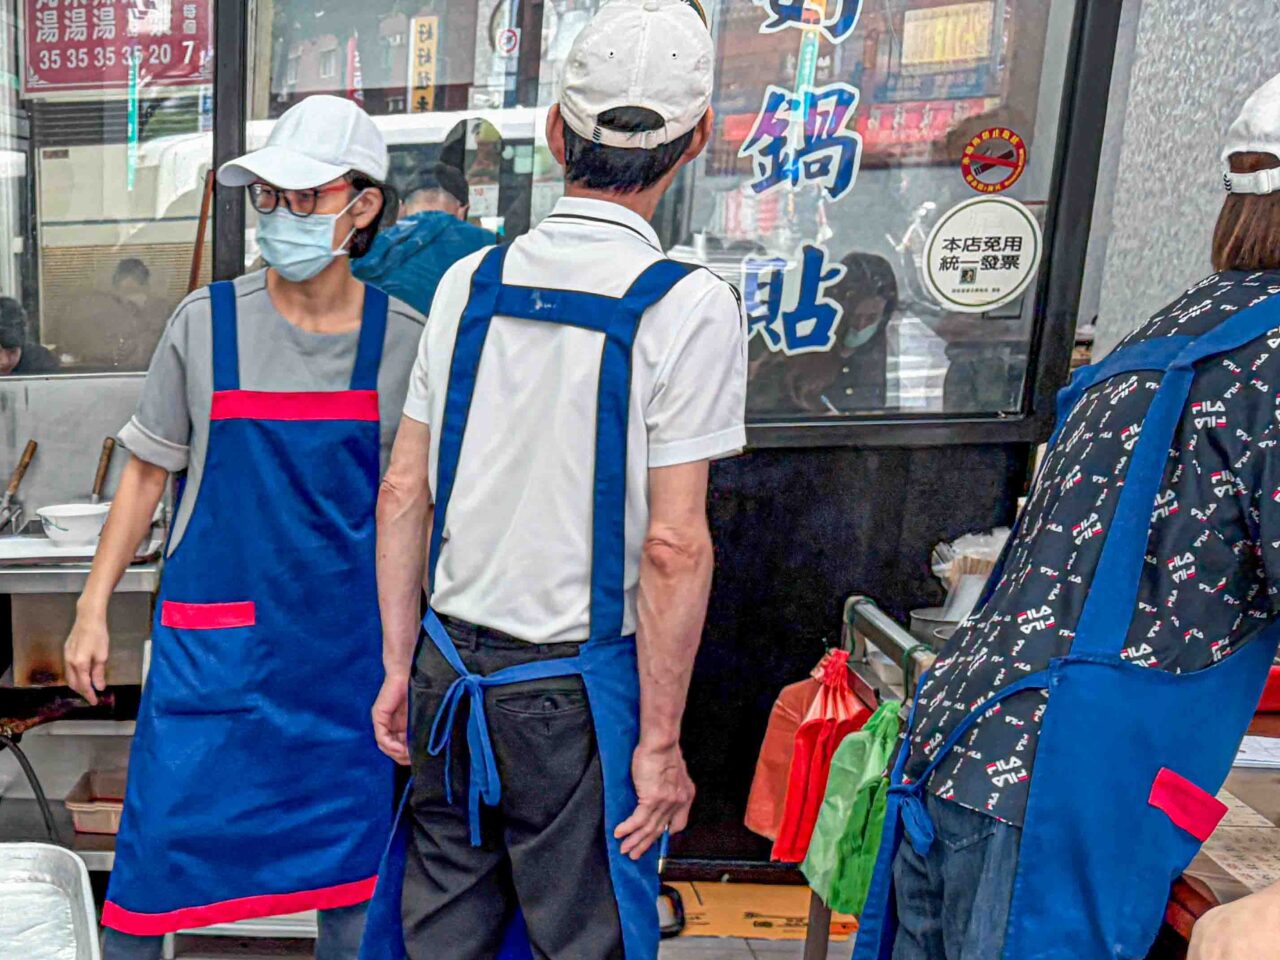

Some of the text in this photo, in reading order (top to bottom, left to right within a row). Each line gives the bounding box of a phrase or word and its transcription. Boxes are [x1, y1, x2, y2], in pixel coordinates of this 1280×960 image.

[64, 0, 88, 41] 湯
[92, 0, 116, 40] 湯
[39, 49, 61, 70] 35
[67, 48, 89, 68] 35
[94, 46, 116, 67] 35
[148, 43, 172, 64] 20
[182, 40, 195, 65] 7
[941, 236, 1022, 253] 本店免用
[938, 254, 1020, 271] 統一發票
[1191, 400, 1225, 414] FILA
[1194, 415, 1228, 430] FILA
[1072, 512, 1099, 536] FILA
[1075, 522, 1104, 545] FILA
[1167, 552, 1196, 571] FILA
[1172, 565, 1197, 584] FILA
[1017, 605, 1053, 624] FILA
[1020, 616, 1056, 635] FILA
[1119, 642, 1153, 660] FILA
[985, 756, 1023, 775] FILA
[991, 768, 1030, 788] FILA
